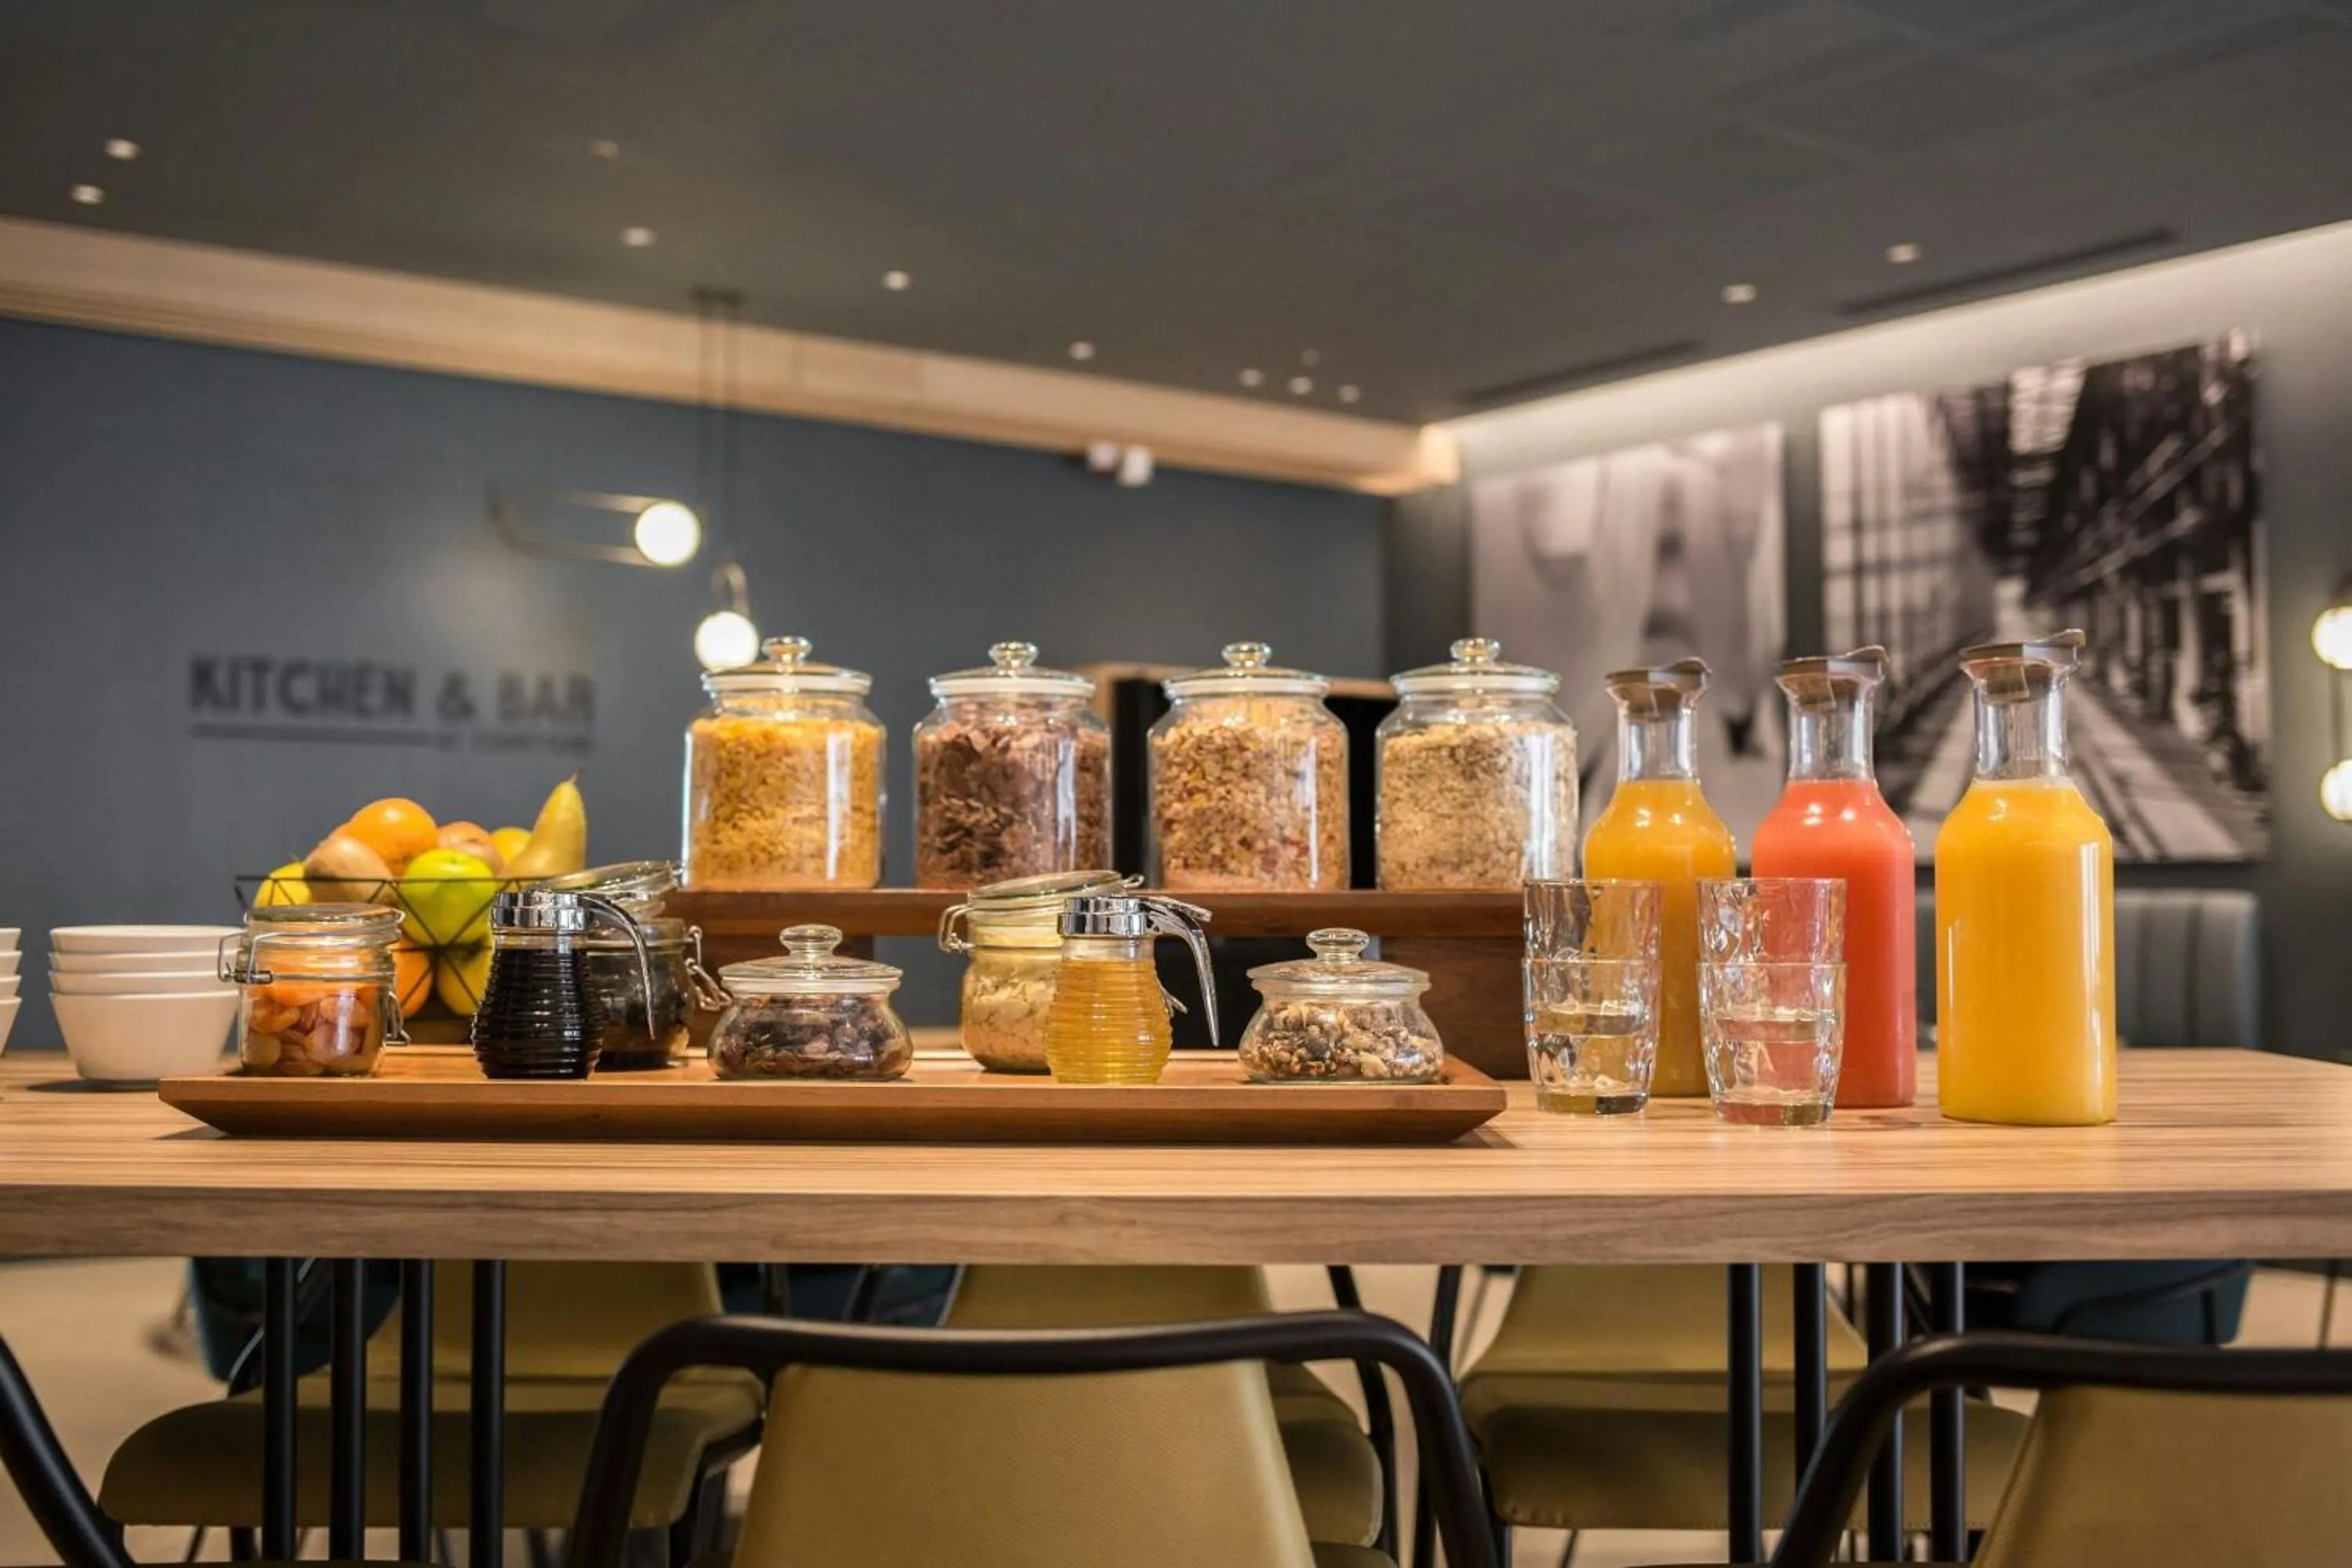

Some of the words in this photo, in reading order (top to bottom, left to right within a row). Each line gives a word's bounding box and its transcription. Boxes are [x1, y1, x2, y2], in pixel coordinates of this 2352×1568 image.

[189, 655, 416, 718] KITCHEN
[436, 671, 477, 721] &
[497, 670, 596, 723] BAR
